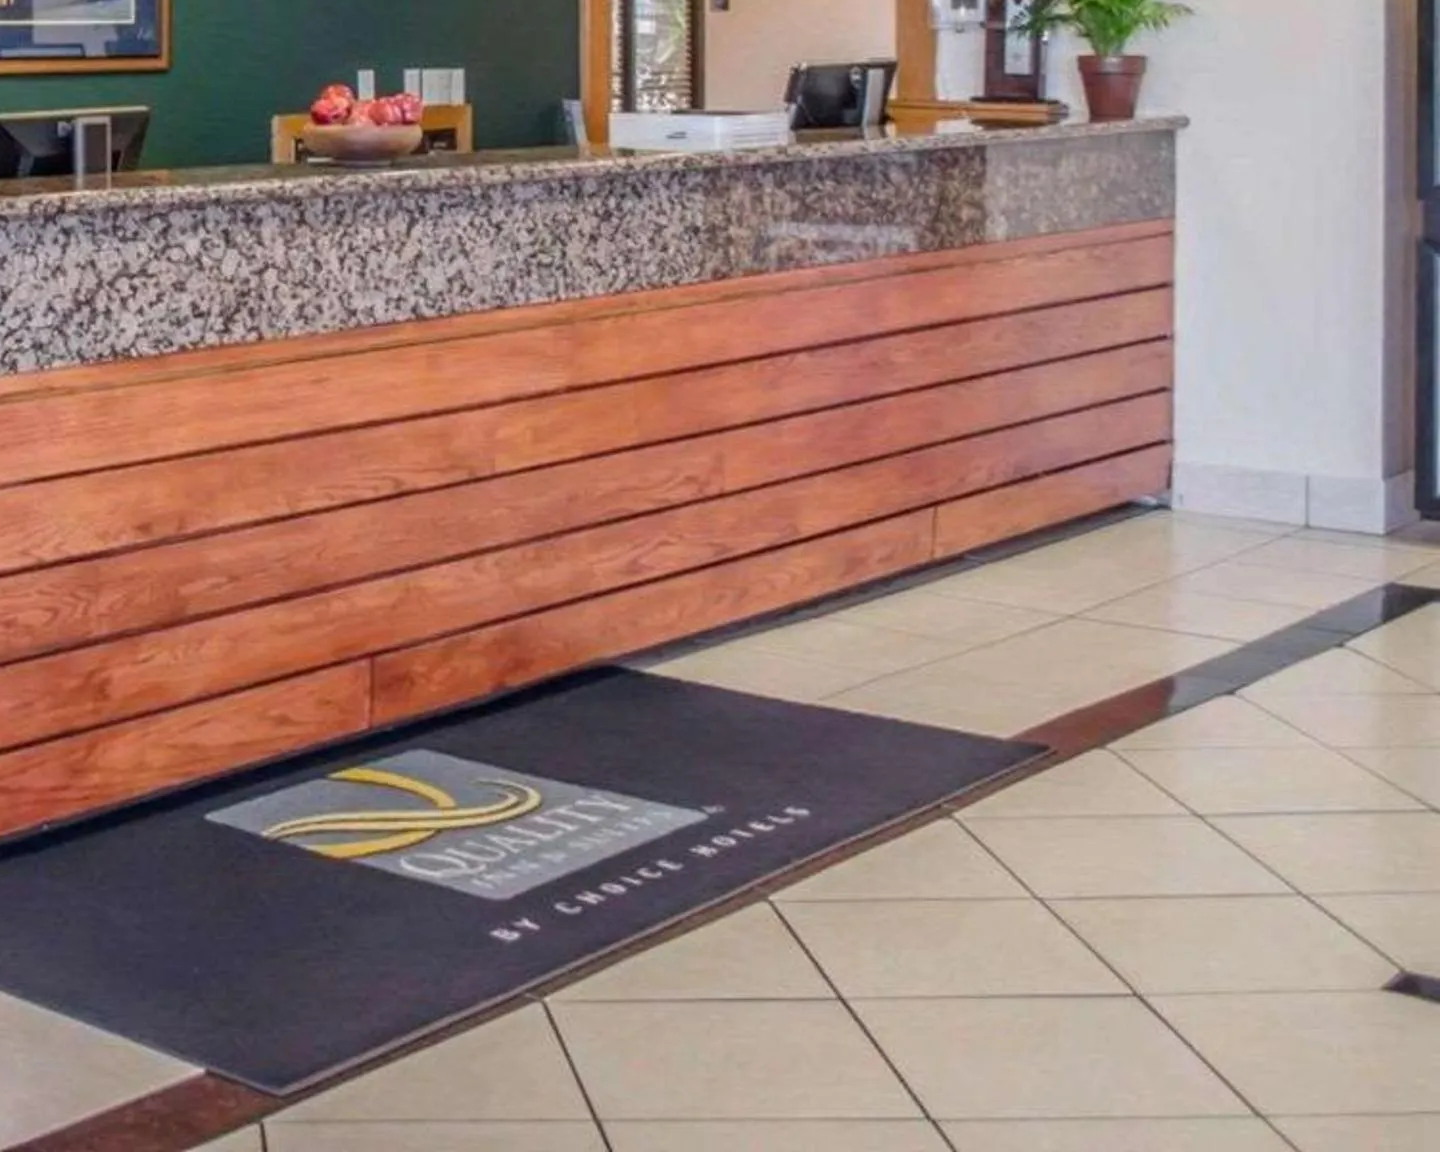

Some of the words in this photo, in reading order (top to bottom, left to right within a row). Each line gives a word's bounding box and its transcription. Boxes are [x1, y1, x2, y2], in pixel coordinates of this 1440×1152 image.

[398, 794, 632, 878] QUALITY
[489, 917, 541, 943] BY
[554, 858, 685, 916] CHOICE
[689, 804, 810, 858] HOTELS
